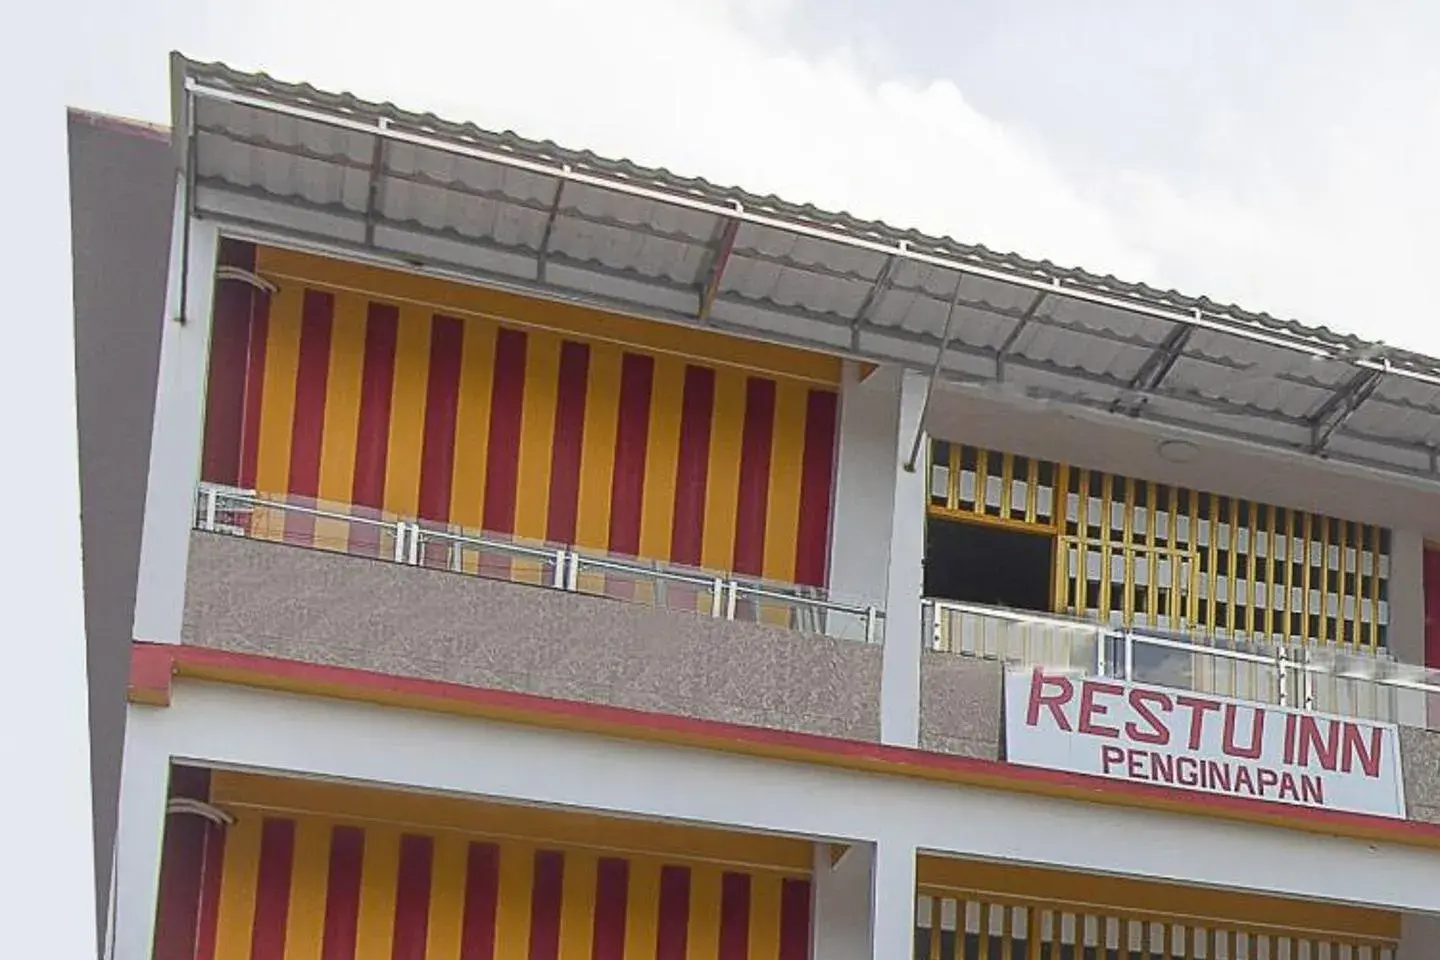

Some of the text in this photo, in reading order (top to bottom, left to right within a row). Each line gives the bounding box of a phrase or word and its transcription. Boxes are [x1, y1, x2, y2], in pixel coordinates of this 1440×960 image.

[1027, 666, 1382, 778] RESTU INN
[1102, 745, 1323, 805] PENGINAPAN
